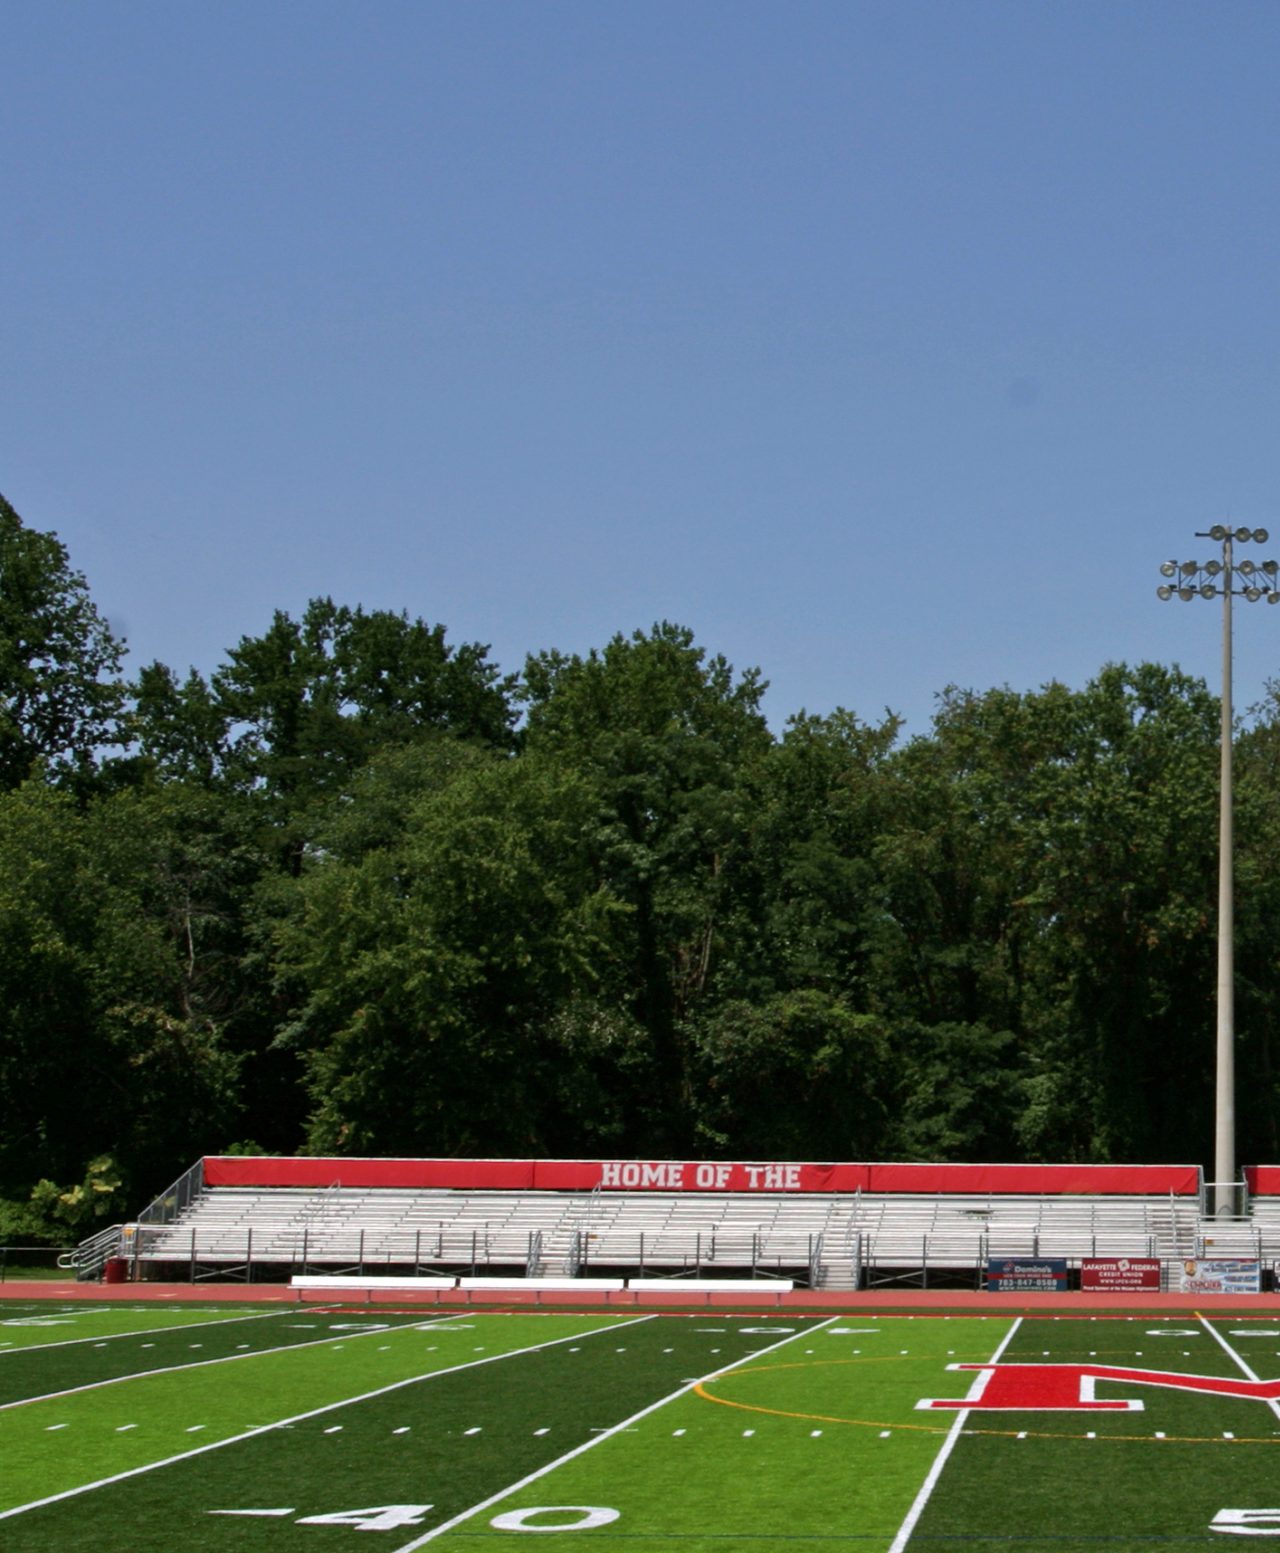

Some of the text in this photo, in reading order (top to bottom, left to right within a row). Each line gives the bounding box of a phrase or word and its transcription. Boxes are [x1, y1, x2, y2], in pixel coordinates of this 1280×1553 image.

[601, 1163, 801, 1188] HOME OF THE
[1083, 1263, 1117, 1271] LAFAYETTE
